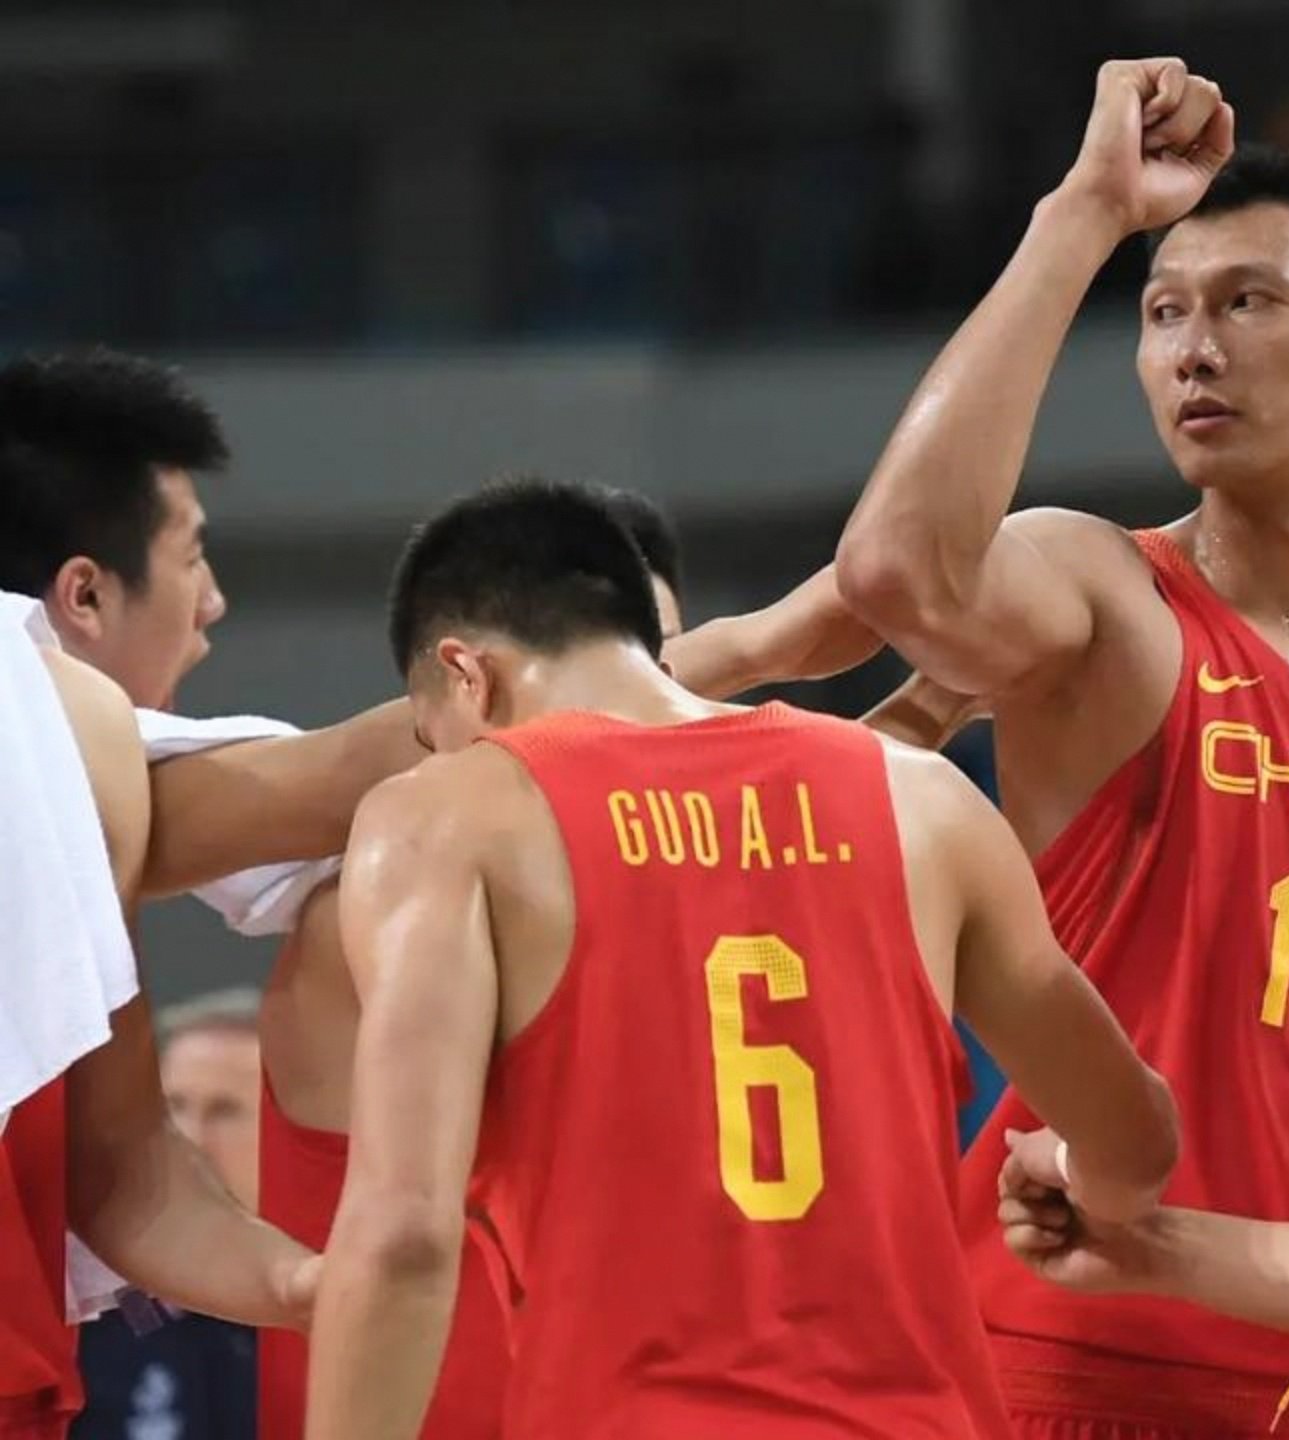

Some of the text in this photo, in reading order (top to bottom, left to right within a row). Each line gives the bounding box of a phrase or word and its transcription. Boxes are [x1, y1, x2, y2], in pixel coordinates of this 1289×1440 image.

[607, 783, 852, 869] GUO A.L.
[704, 934, 824, 1222] 6
